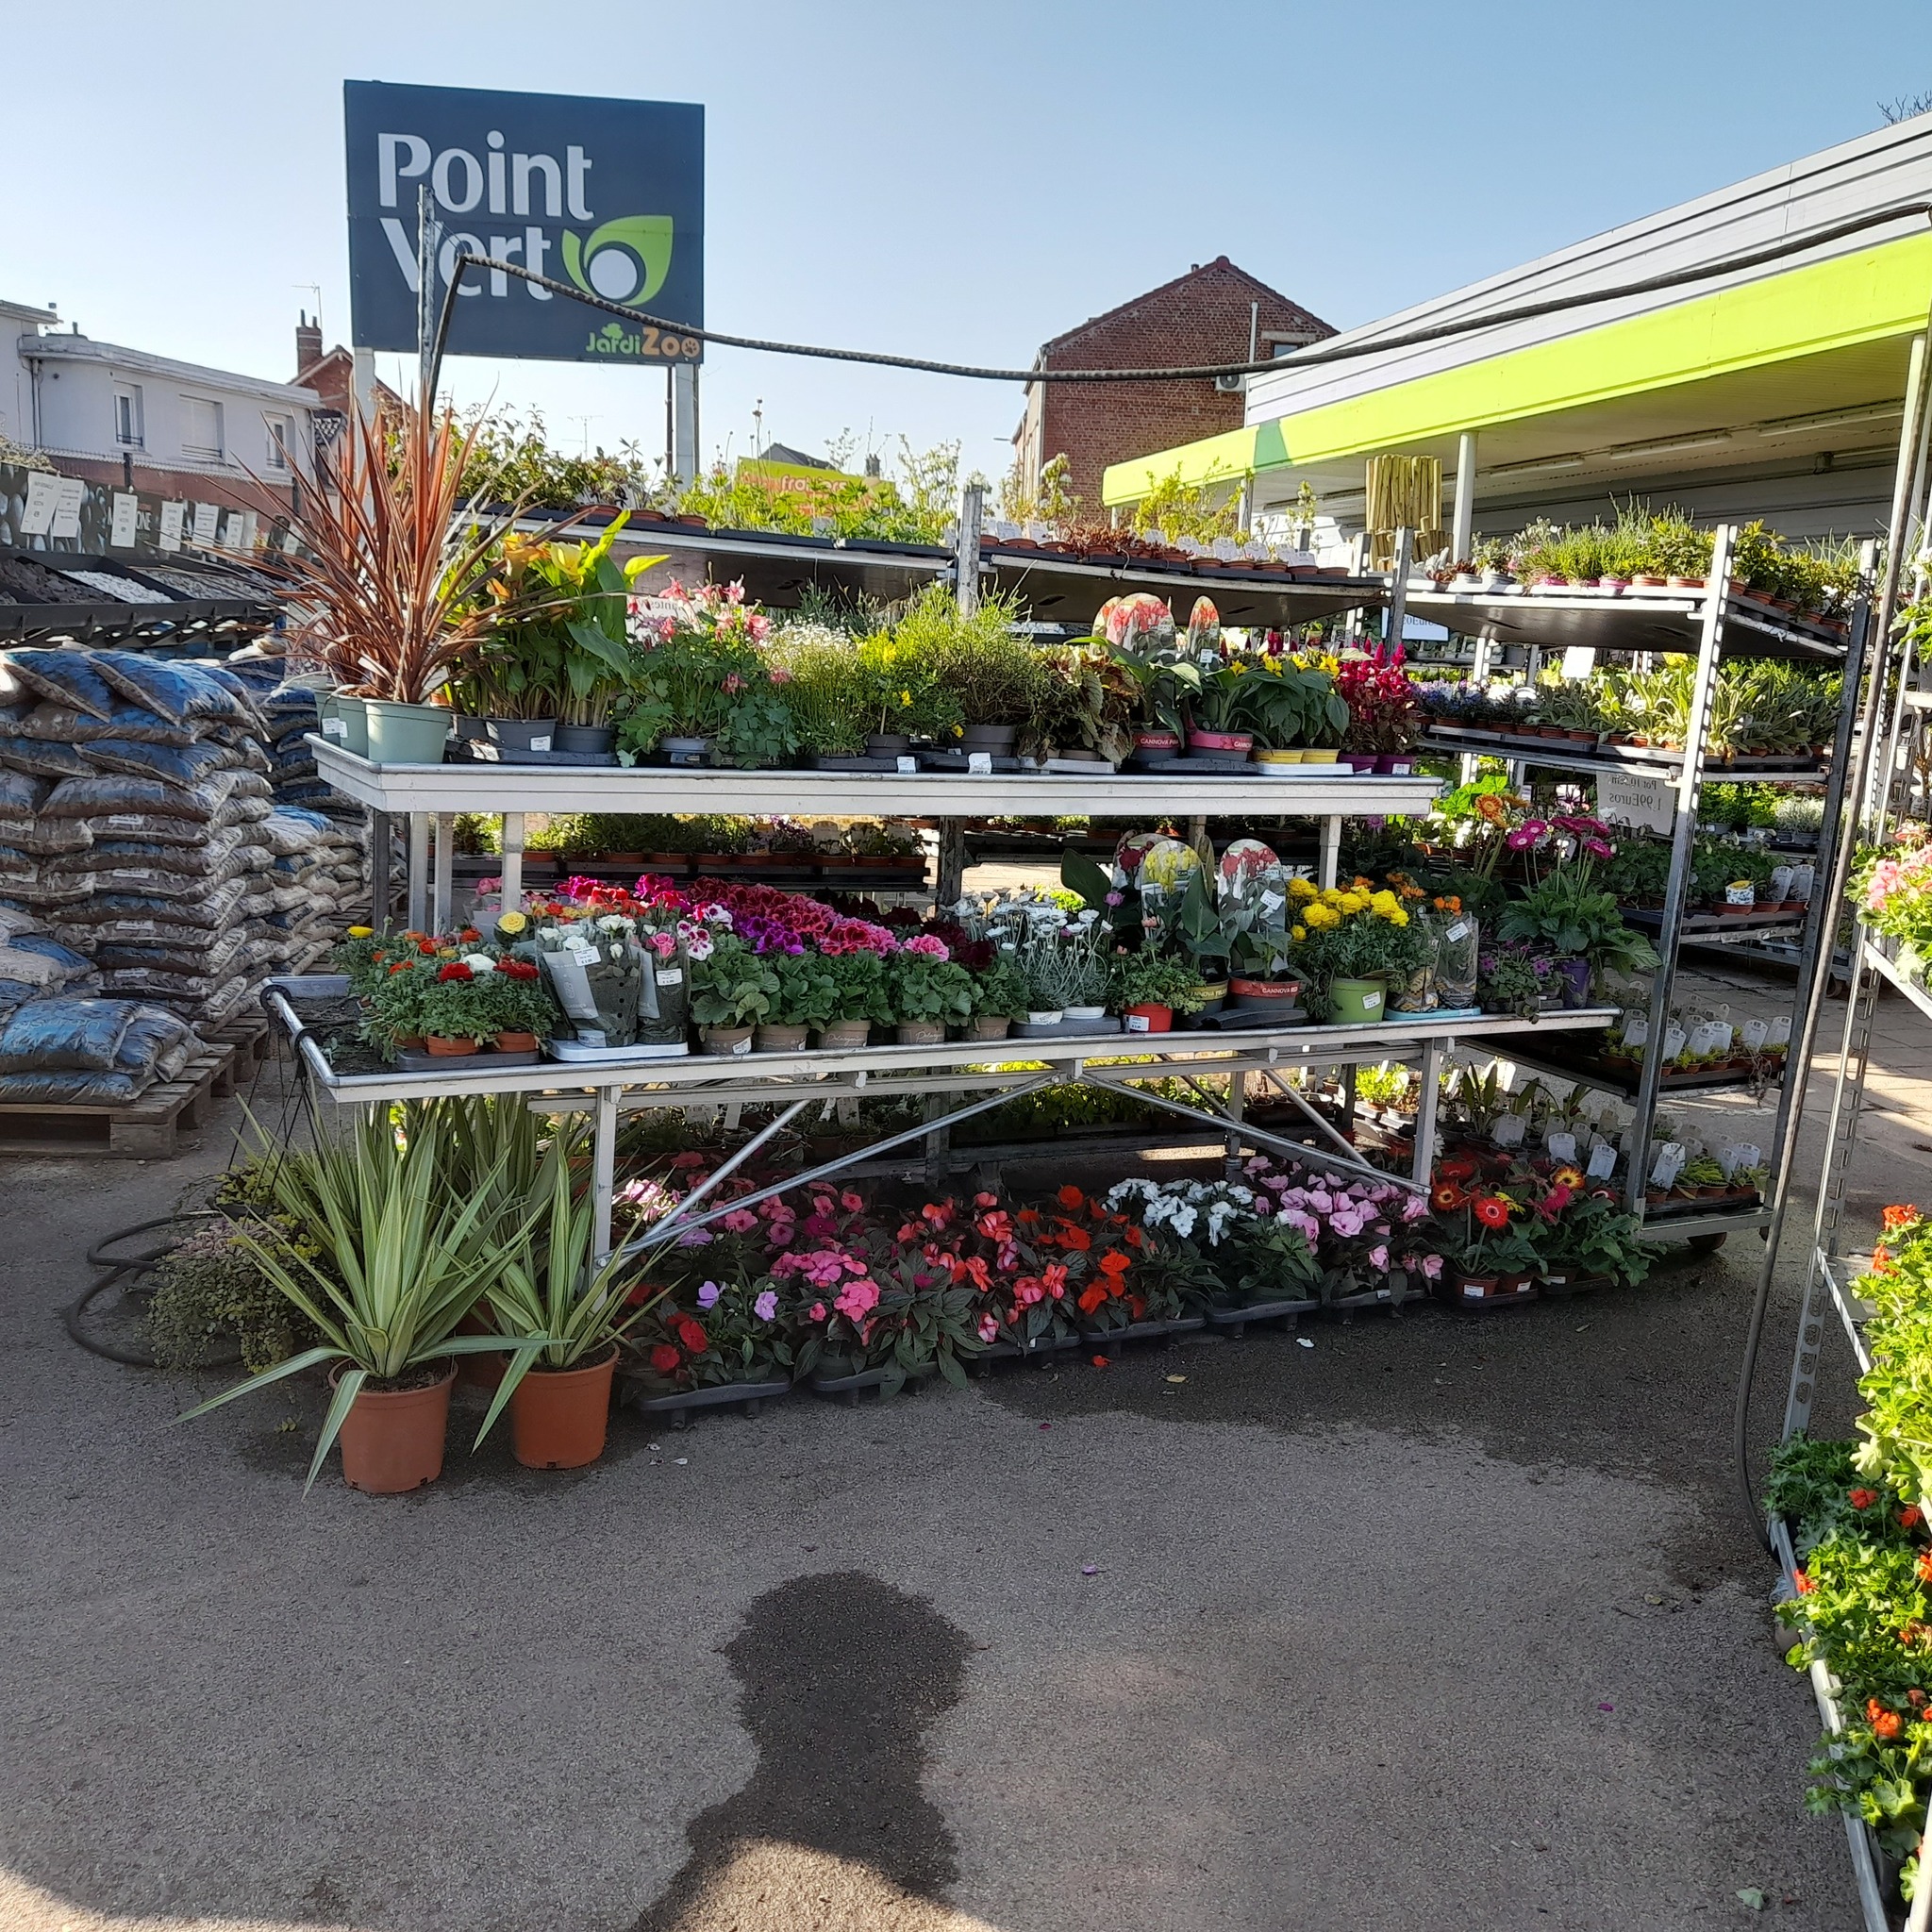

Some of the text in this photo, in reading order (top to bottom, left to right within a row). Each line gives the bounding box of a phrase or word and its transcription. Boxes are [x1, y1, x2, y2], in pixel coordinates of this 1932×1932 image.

[377, 130, 595, 221] Point
[379, 217, 555, 301] Vert
[585, 325, 700, 358] JardiZoo
